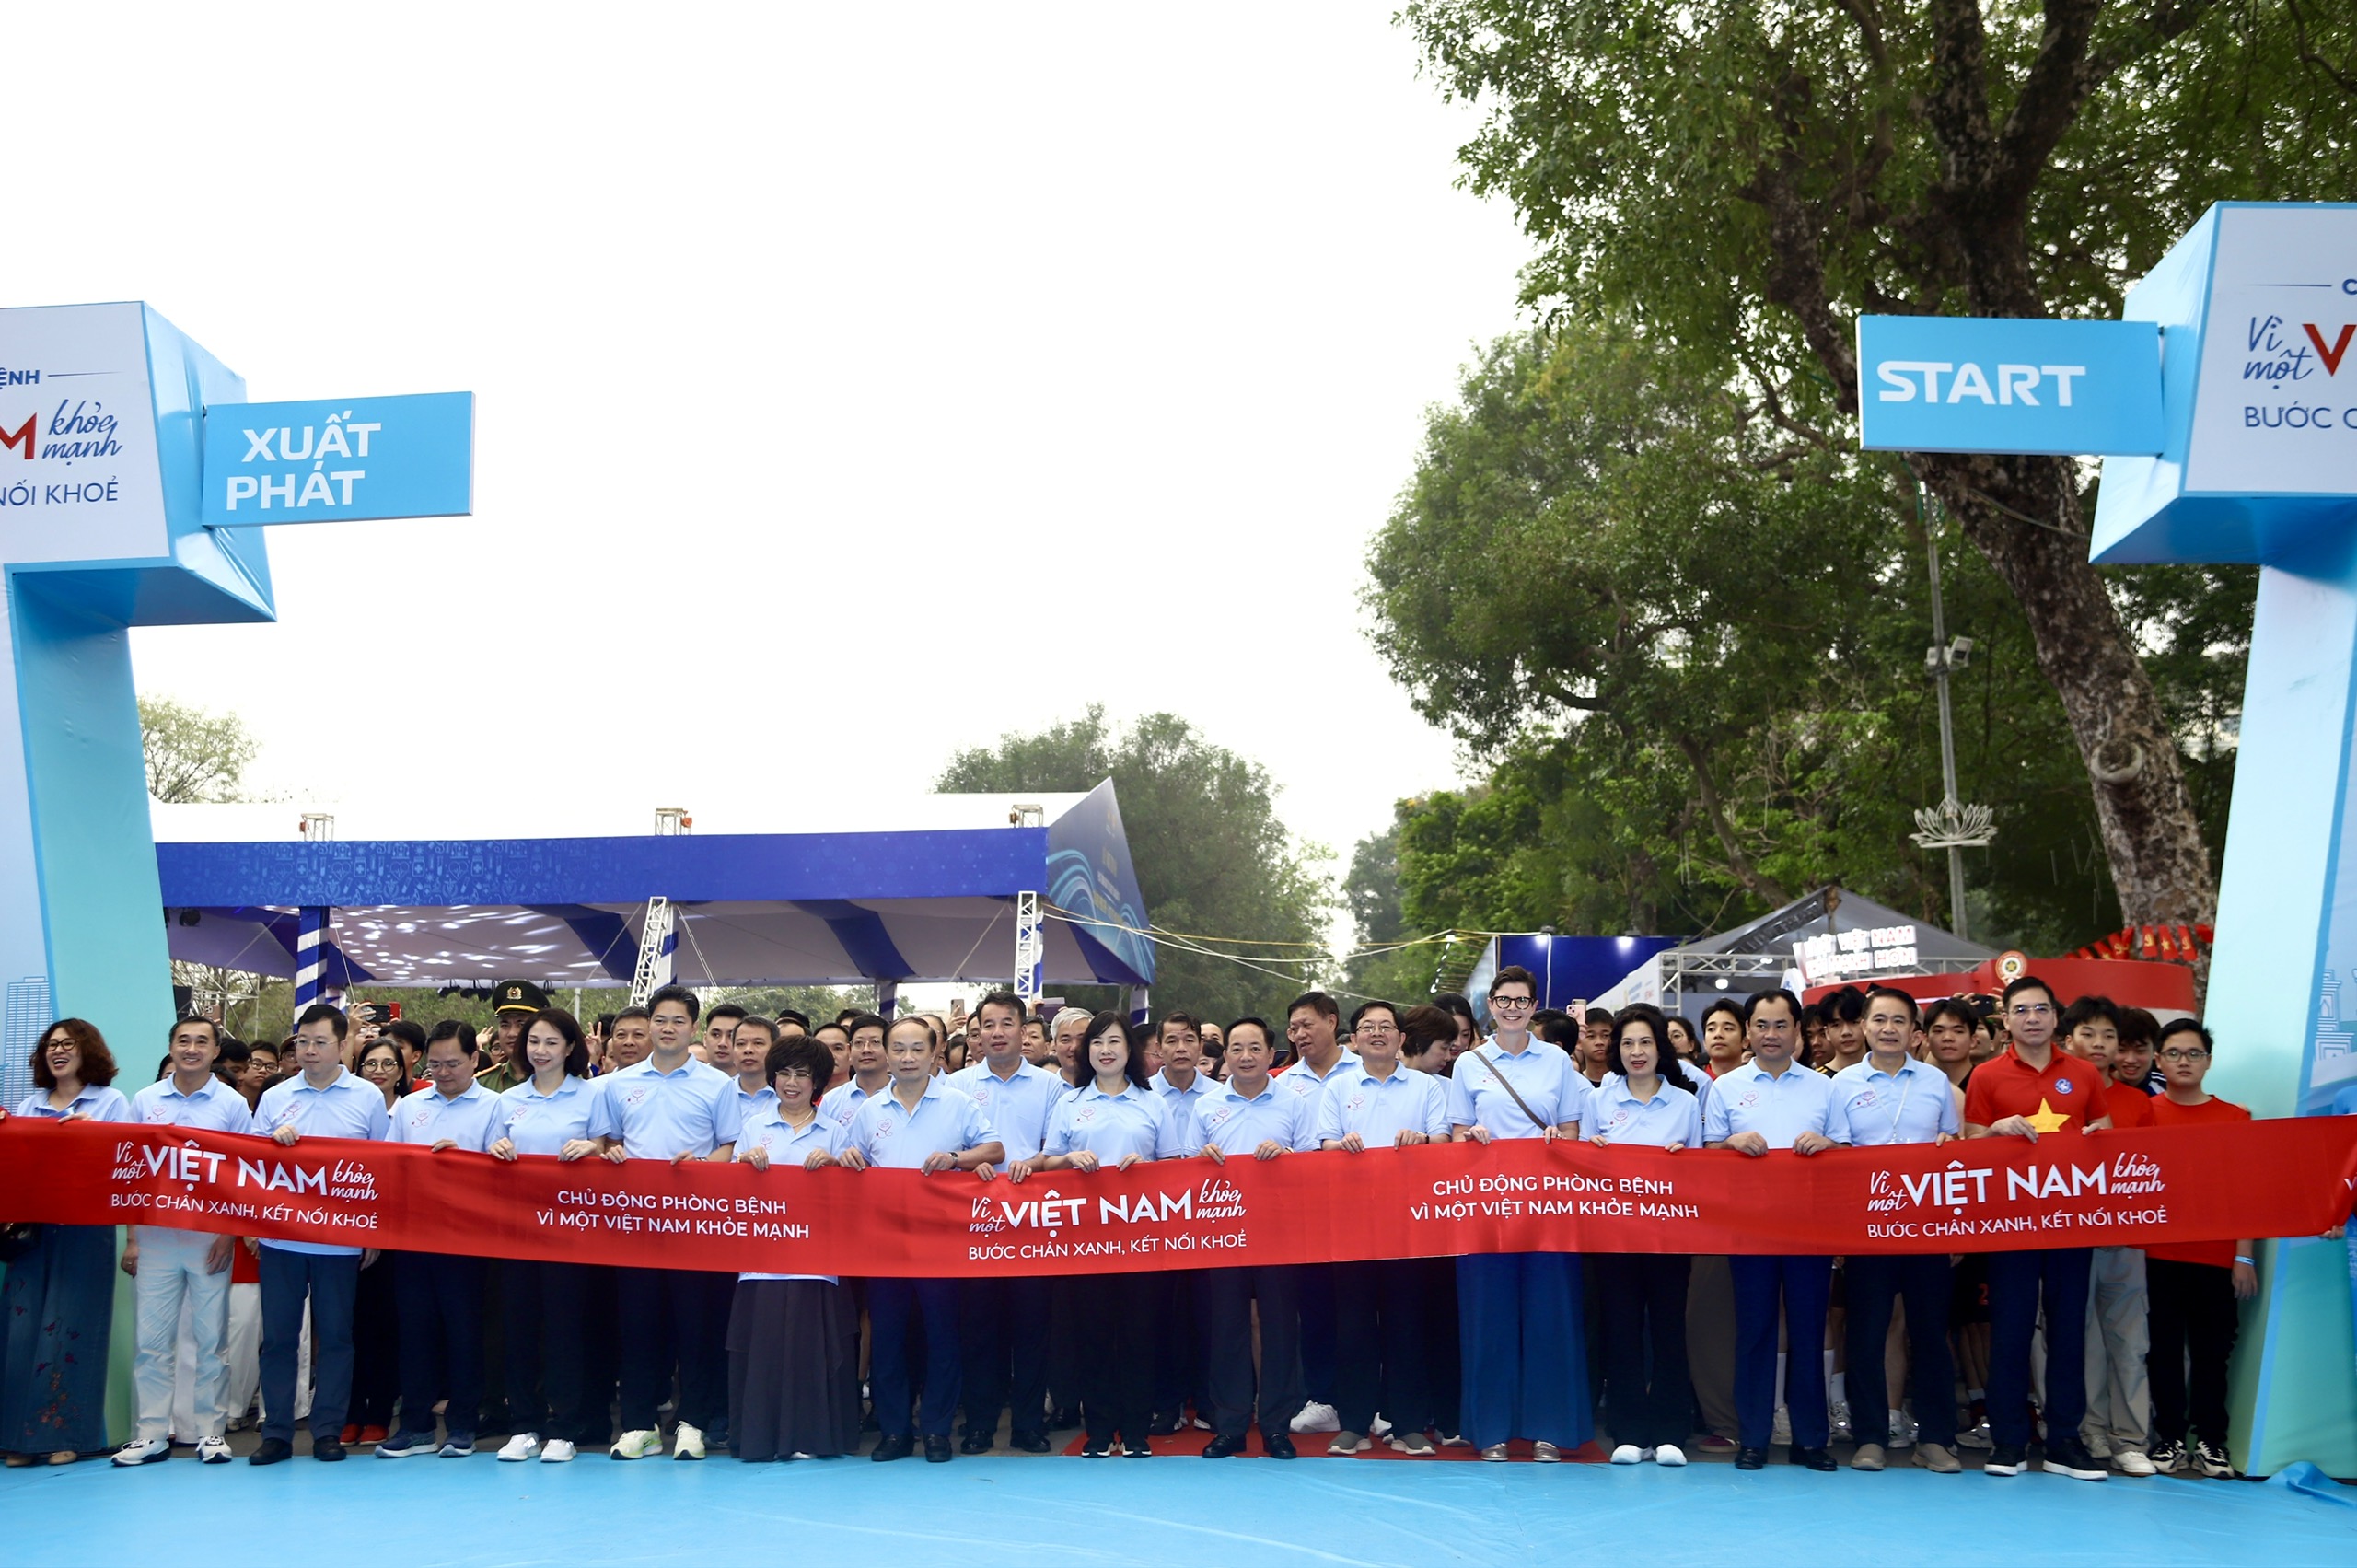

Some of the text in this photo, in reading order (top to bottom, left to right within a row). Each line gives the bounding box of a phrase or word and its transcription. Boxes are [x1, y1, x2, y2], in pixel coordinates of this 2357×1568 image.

[2249, 315, 2283, 352] Vì
[1875, 360, 2086, 407] START
[2243, 346, 2313, 390] một
[48, 399, 118, 436] khỏe
[2244, 400, 2333, 430] BƯỚC
[41, 421, 123, 466] mạnh
[241, 410, 382, 462] XUẤT
[45, 475, 119, 505] KHOẺ
[226, 461, 366, 512] PHÁT
[116, 1141, 134, 1163] Vì
[142, 1139, 328, 1196] VIỆT NAM
[2112, 1152, 2159, 1179] khỏe
[111, 1158, 147, 1185] một
[332, 1159, 373, 1184] khỏe
[1432, 1173, 1673, 1197] CHỦ ĐỘNG PHÒNG BỆNH
[1870, 1170, 1891, 1195] Vì
[2110, 1168, 2166, 1200] mạnh
[331, 1177, 378, 1202] mạnh
[557, 1187, 786, 1217] CHỦ ĐỘNG PHÒNG BỆNH
[1198, 1178, 1239, 1204] khỏe
[1866, 1189, 1909, 1217] một
[1899, 1159, 2107, 1216] VIỆT NAM
[111, 1190, 378, 1229] BƯỚC CHÂN XANH, KẾT NỐI KHOẺ
[971, 1196, 992, 1219] Vì
[1000, 1187, 1192, 1238] VIỆT NAM
[1196, 1193, 1247, 1224] mạnh
[1410, 1197, 1699, 1222] VÌ MỘT VIỆT NAM KHỎE MẠNH
[1867, 1204, 2168, 1238] BƯỚC CHÂN XANH, KẾT NỐI KHOẺ
[536, 1208, 809, 1241] VÌ MỘT VIỆT NAM KHỎE MẠNH
[969, 1214, 1006, 1238] một
[968, 1227, 1248, 1260] BƯỚC CHÂN XANH, KẾT NỐI KHOẺ
